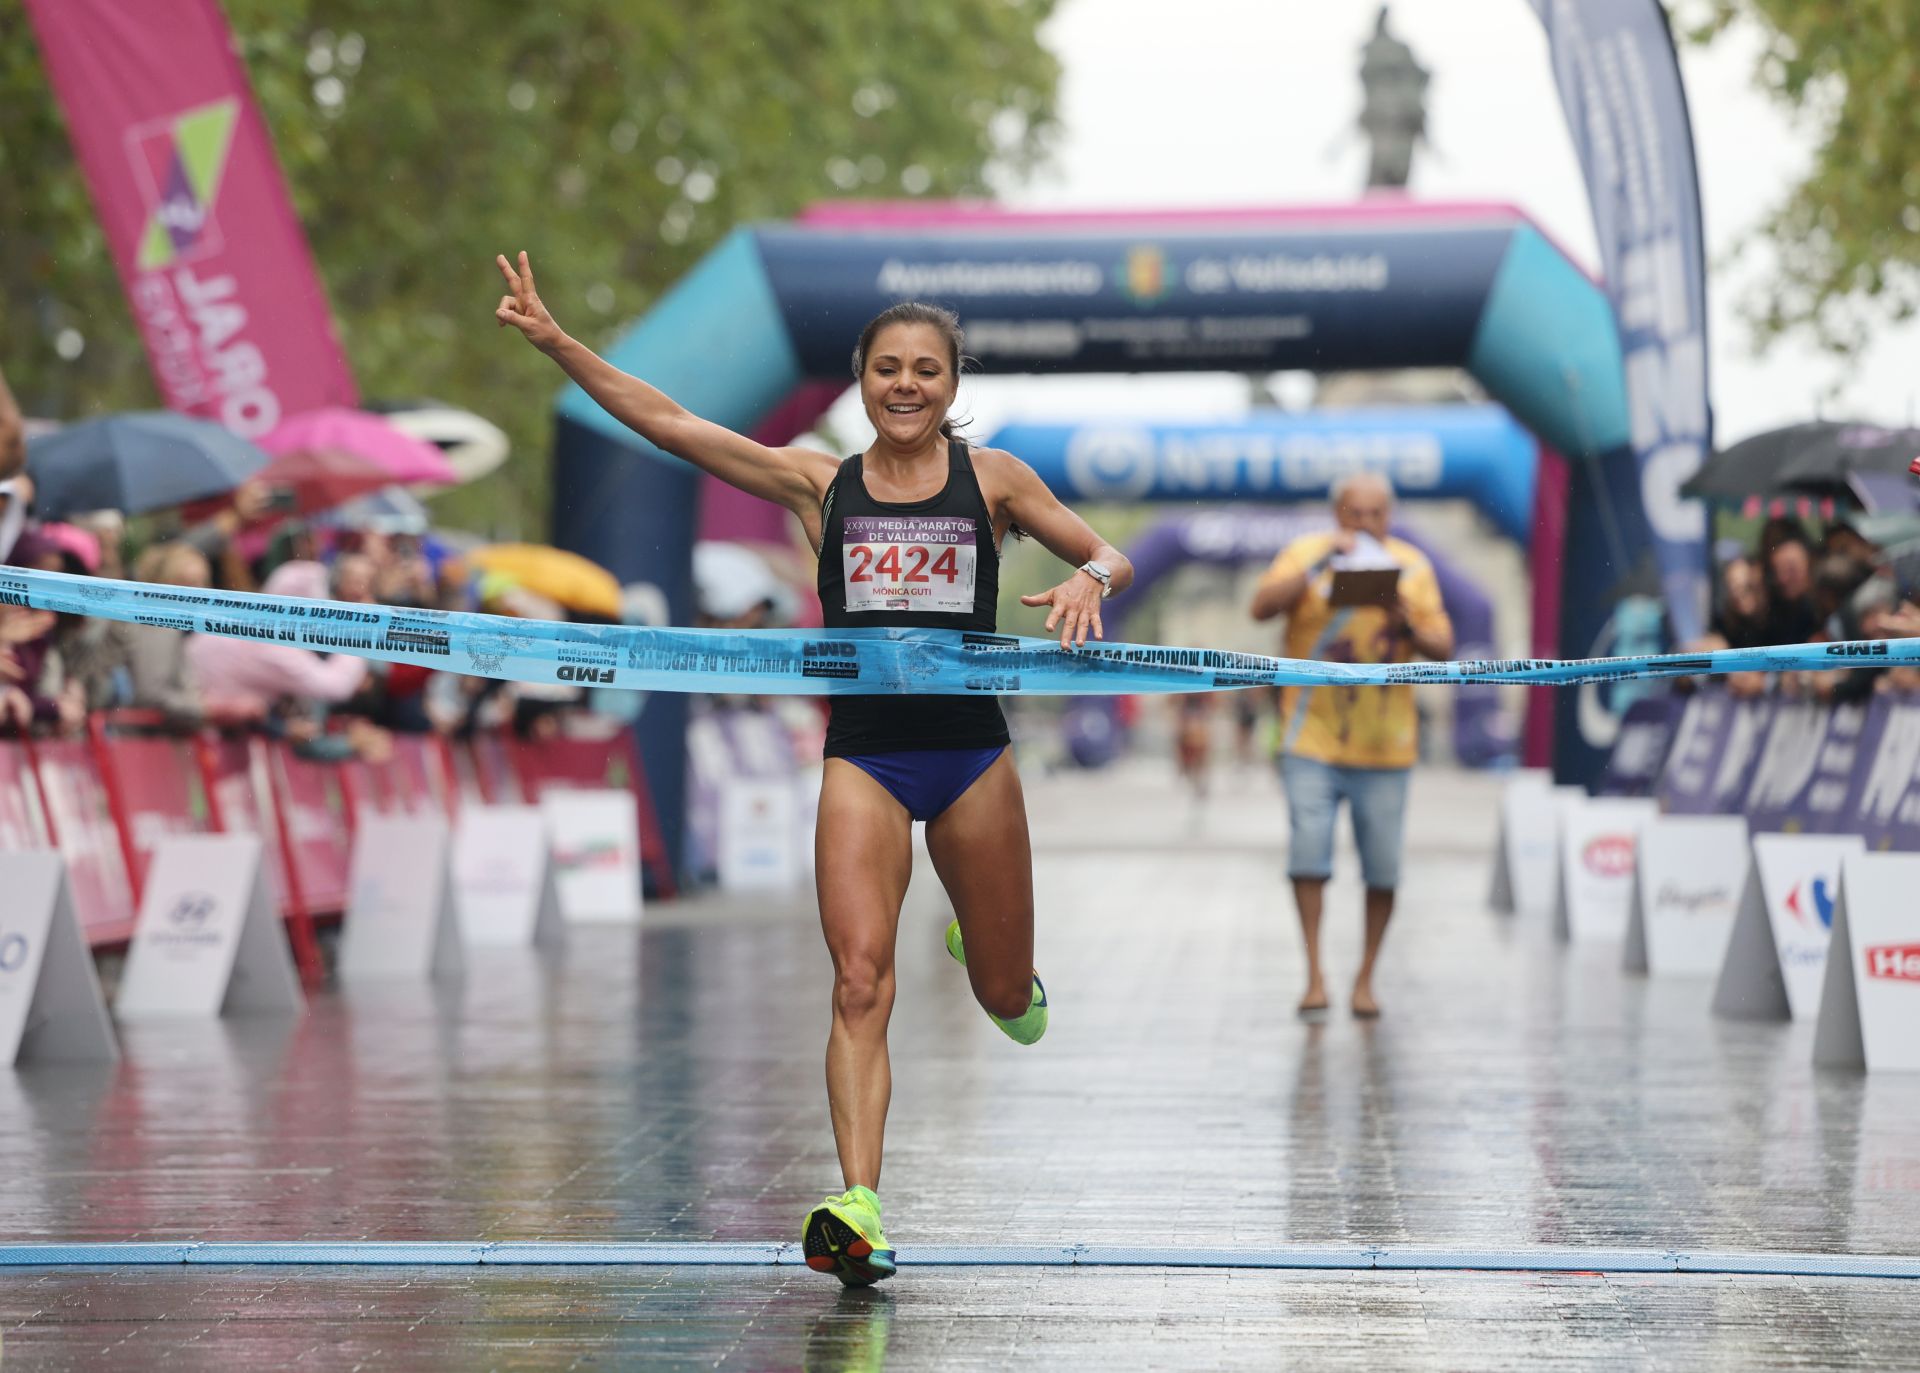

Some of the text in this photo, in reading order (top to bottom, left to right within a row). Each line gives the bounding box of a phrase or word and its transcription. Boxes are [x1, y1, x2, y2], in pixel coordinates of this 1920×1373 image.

[879, 261, 1101, 297] Ayuntamiento
[1231, 256, 1388, 292] Valladolid
[846, 521, 875, 530] XXXVI
[918, 520, 973, 532] MARATÓN
[869, 532, 959, 543] DE VALLADOLID
[849, 545, 959, 584] 2424
[0, 581, 28, 589] rtes
[872, 586, 932, 596] MÓNICA GUTI
[309, 607, 380, 624] DEPORTES
[388, 625, 448, 636] Deportes
[557, 648, 618, 658] Municipal
[802, 641, 857, 658] FMD
[1826, 642, 1888, 656] FMD
[557, 656, 617, 666] Fundación
[803, 660, 857, 669] Deportes
[556, 665, 617, 684] FMD
